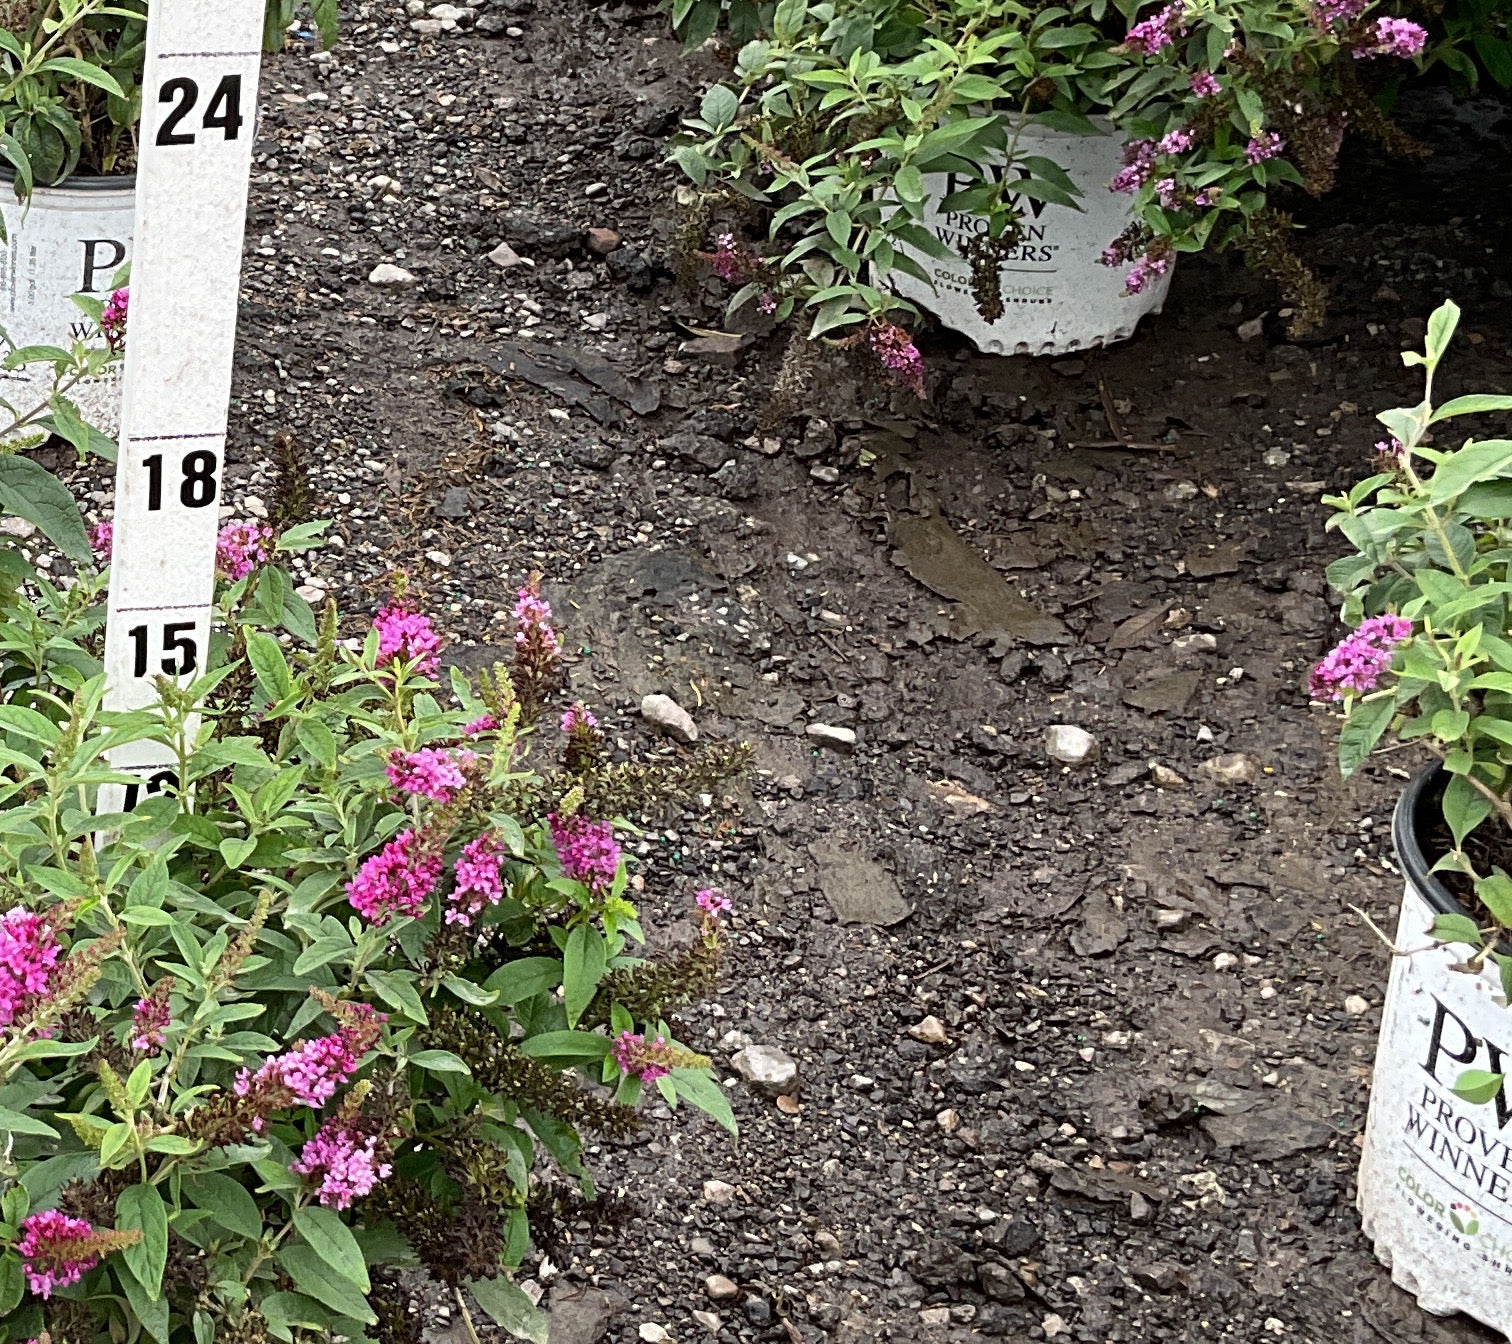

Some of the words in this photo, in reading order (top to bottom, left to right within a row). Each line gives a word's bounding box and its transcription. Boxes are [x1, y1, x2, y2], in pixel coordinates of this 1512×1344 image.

[155, 74, 244, 147] 24
[935, 226, 1053, 262] WINERS
[945, 212, 1047, 241] PRON
[75, 239, 133, 294] P
[934, 268, 973, 285] COLO
[1003, 284, 1054, 297] CHOICE
[142, 449, 218, 511] 18
[127, 621, 199, 679] 15
[1403, 1101, 1511, 1203] WINNE
[1420, 1083, 1512, 1174] PROVE
[1395, 1182, 1472, 1251] FLOWERING
[1397, 1166, 1446, 1219] COLOR
